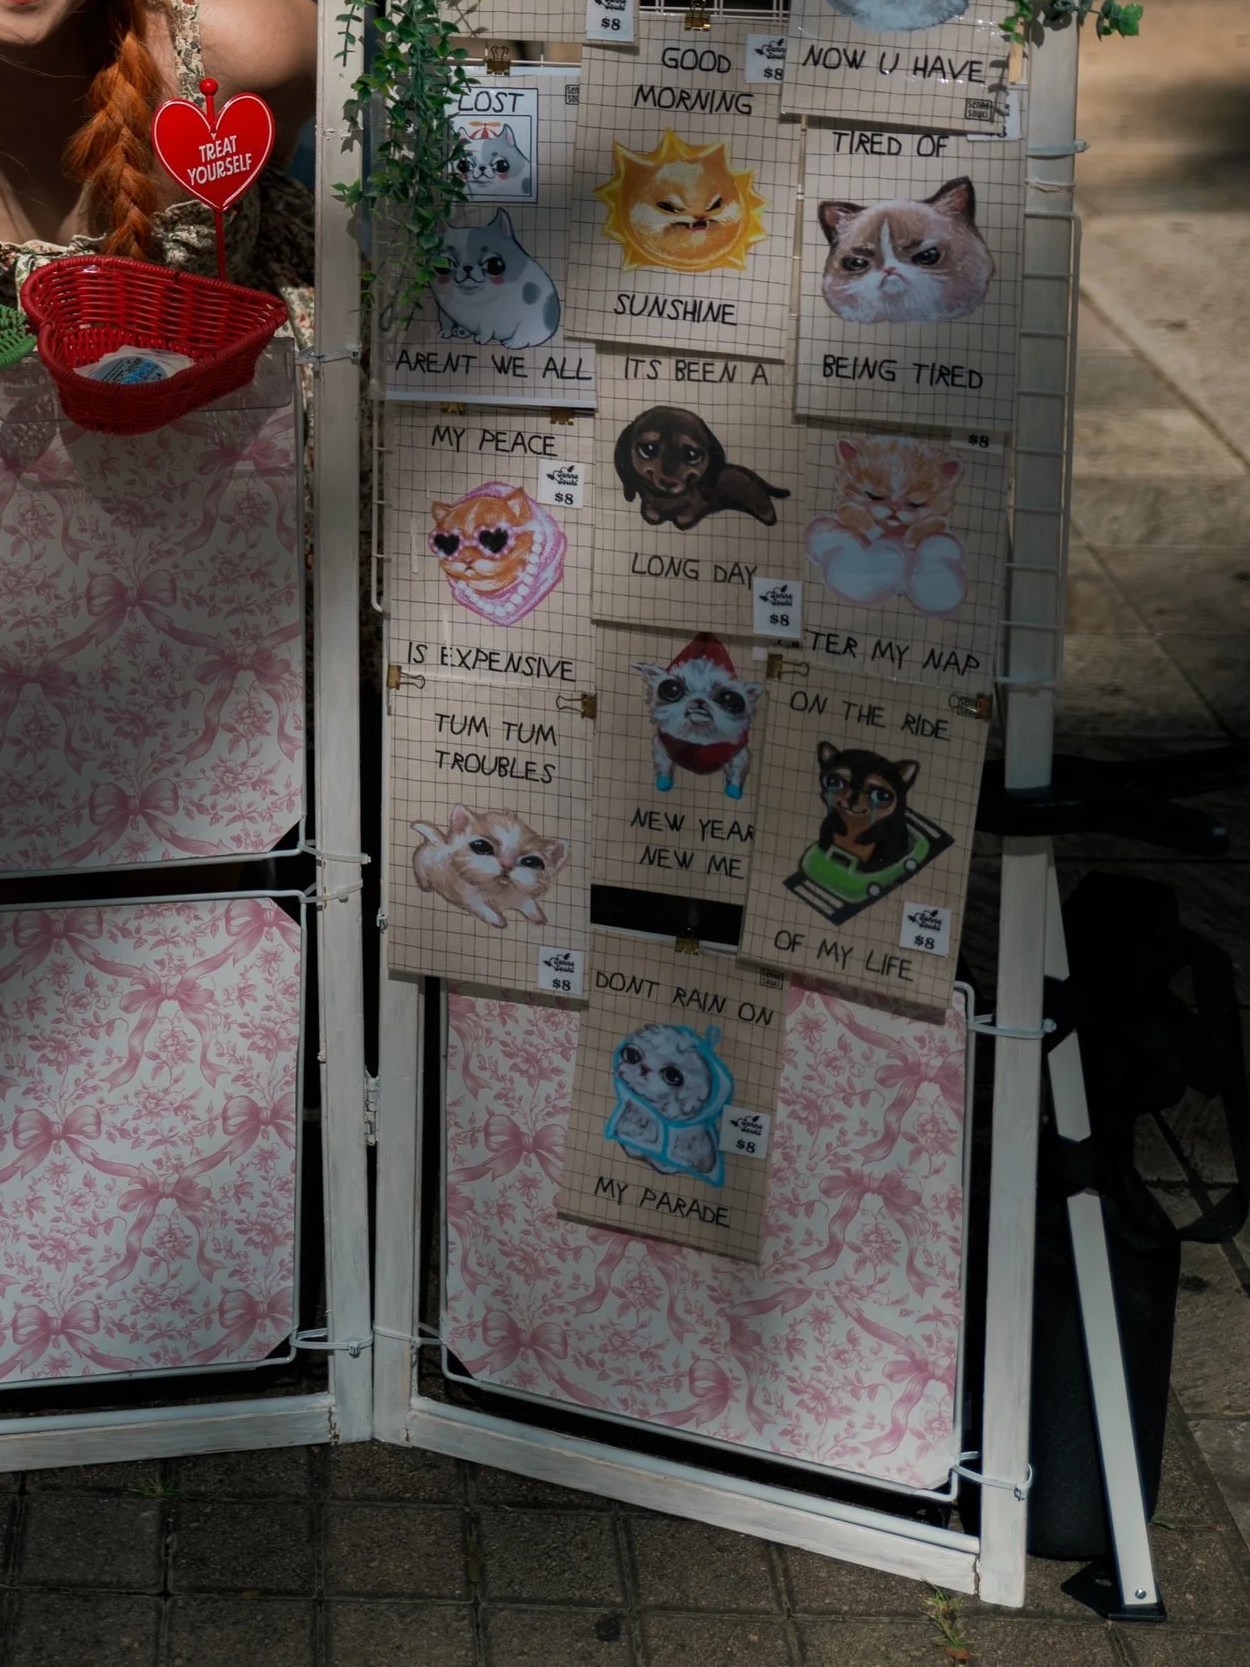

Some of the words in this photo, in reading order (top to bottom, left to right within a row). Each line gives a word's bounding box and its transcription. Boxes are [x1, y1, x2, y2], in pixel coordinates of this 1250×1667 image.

[601, 18, 620, 30] $8
[661, 47, 732, 75] GOOD
[764, 68, 783, 80] $8
[802, 46, 866, 72] NOW
[879, 50, 898, 74] U
[913, 55, 987, 85] HAVE
[456, 91, 525, 113] LOST
[634, 85, 754, 115] MORNING
[199, 135, 238, 162] TREAT
[833, 131, 903, 156] TIRED
[916, 135, 951, 157] OF
[187, 152, 253, 187] YOURSELF
[614, 293, 738, 327] SUNSHINE
[395, 349, 476, 374] ARENT
[492, 355, 526, 379] WE
[543, 356, 593, 382] ALL
[625, 357, 661, 380] ITS
[674, 359, 738, 385] BEEN
[751, 364, 768, 386] A
[823, 354, 897, 385] BEING
[913, 362, 984, 390] TIRED
[431, 425, 469, 449] MY
[479, 429, 558, 457] PEACE
[968, 434, 989, 448] $8
[555, 493, 573, 505] $8
[632, 553, 699, 582] LONG
[714, 564, 758, 590] DAY
[770, 614, 789, 626] $8
[408, 643, 427, 665] IS
[440, 645, 576, 682] EXPENSIVE
[872, 638, 910, 669] MY
[922, 647, 981, 678] NAP
[435, 713, 489, 737] TUM
[502, 722, 557, 746] TUM
[790, 691, 828, 715] ON
[842, 700, 886, 729] THE
[901, 712, 950, 742] RIDE
[435, 750, 557, 785] TROUBLES
[631, 808, 686, 832] NEW
[639, 846, 695, 870] NEW
[707, 854, 745, 880] ME
[774, 929, 807, 953] OF
[817, 940, 853, 972] MY
[865, 953, 914, 983] LIFE
[915, 935, 934, 949] $8
[552, 979, 571, 991] $8
[595, 971, 660, 1000] DONT
[673, 987, 727, 1015] RAIN
[738, 1002, 775, 1027] ON
[736, 1139, 756, 1153] $8
[594, 1176, 629, 1207] MY
[640, 1190, 732, 1229] PARADE
